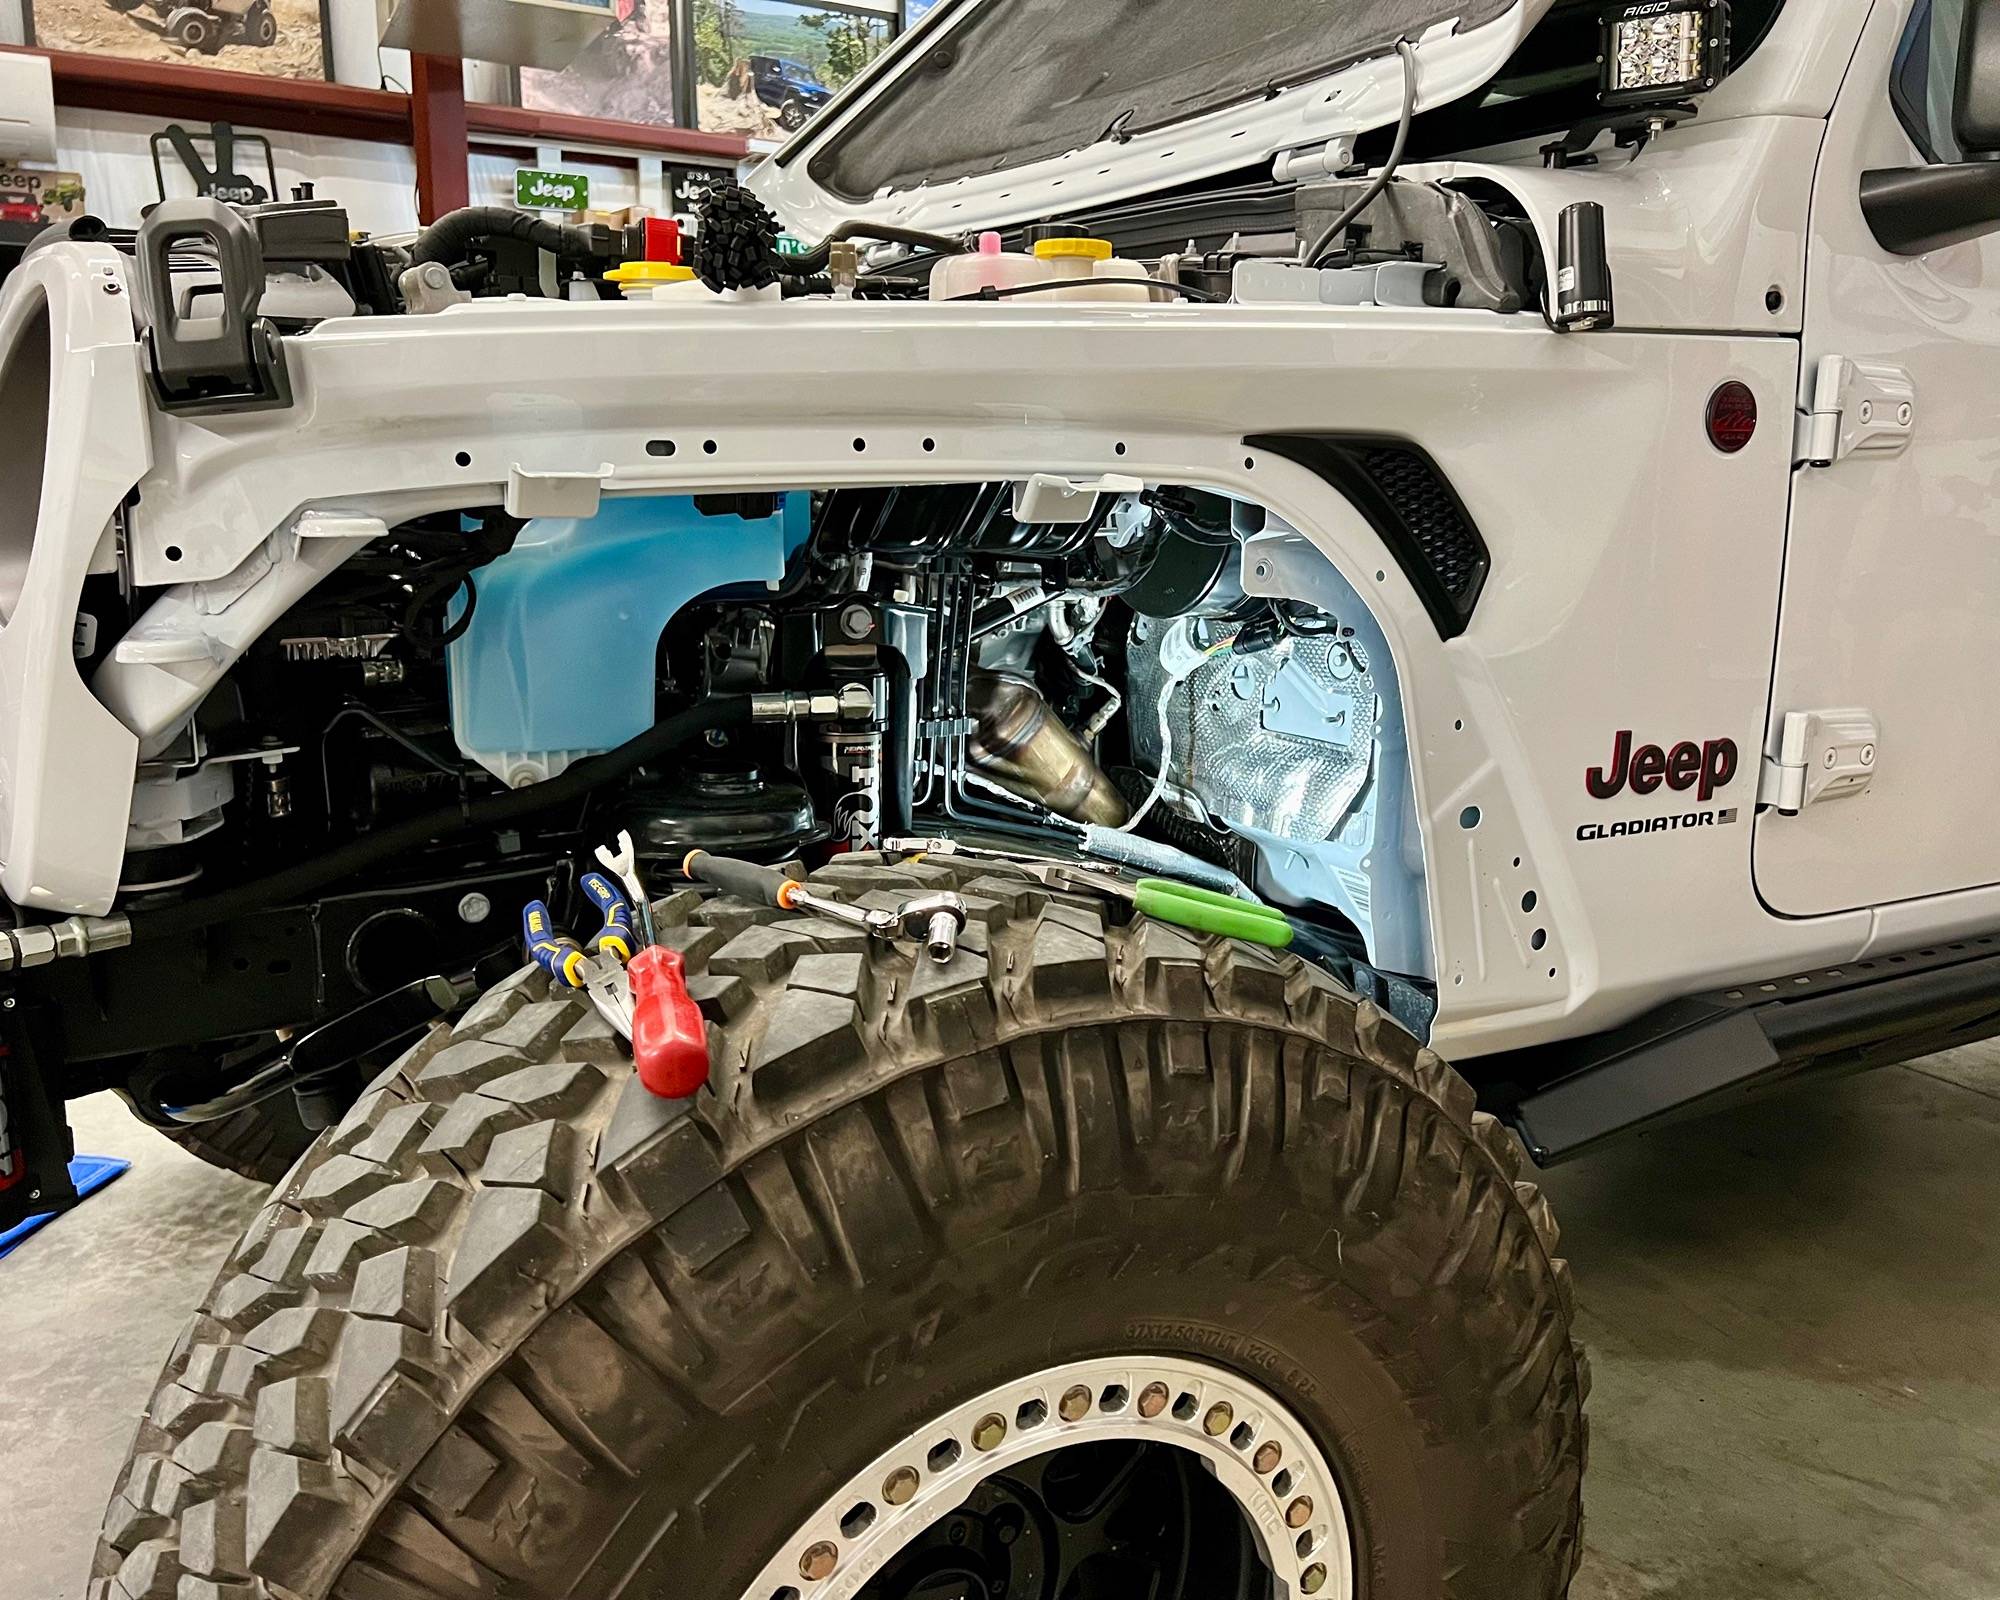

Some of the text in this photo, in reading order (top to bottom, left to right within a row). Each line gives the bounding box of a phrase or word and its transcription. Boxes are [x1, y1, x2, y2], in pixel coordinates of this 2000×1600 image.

[1623, 1, 1670, 17] RIGID
[0, 174, 41, 193] eep
[202, 183, 254, 203] Jeep
[529, 178, 576, 202] Jeep
[675, 180, 701, 200] Je
[1586, 730, 1738, 801] Jeep
[842, 766, 880, 852] FOX
[1576, 811, 1714, 841] GLADIATOR
